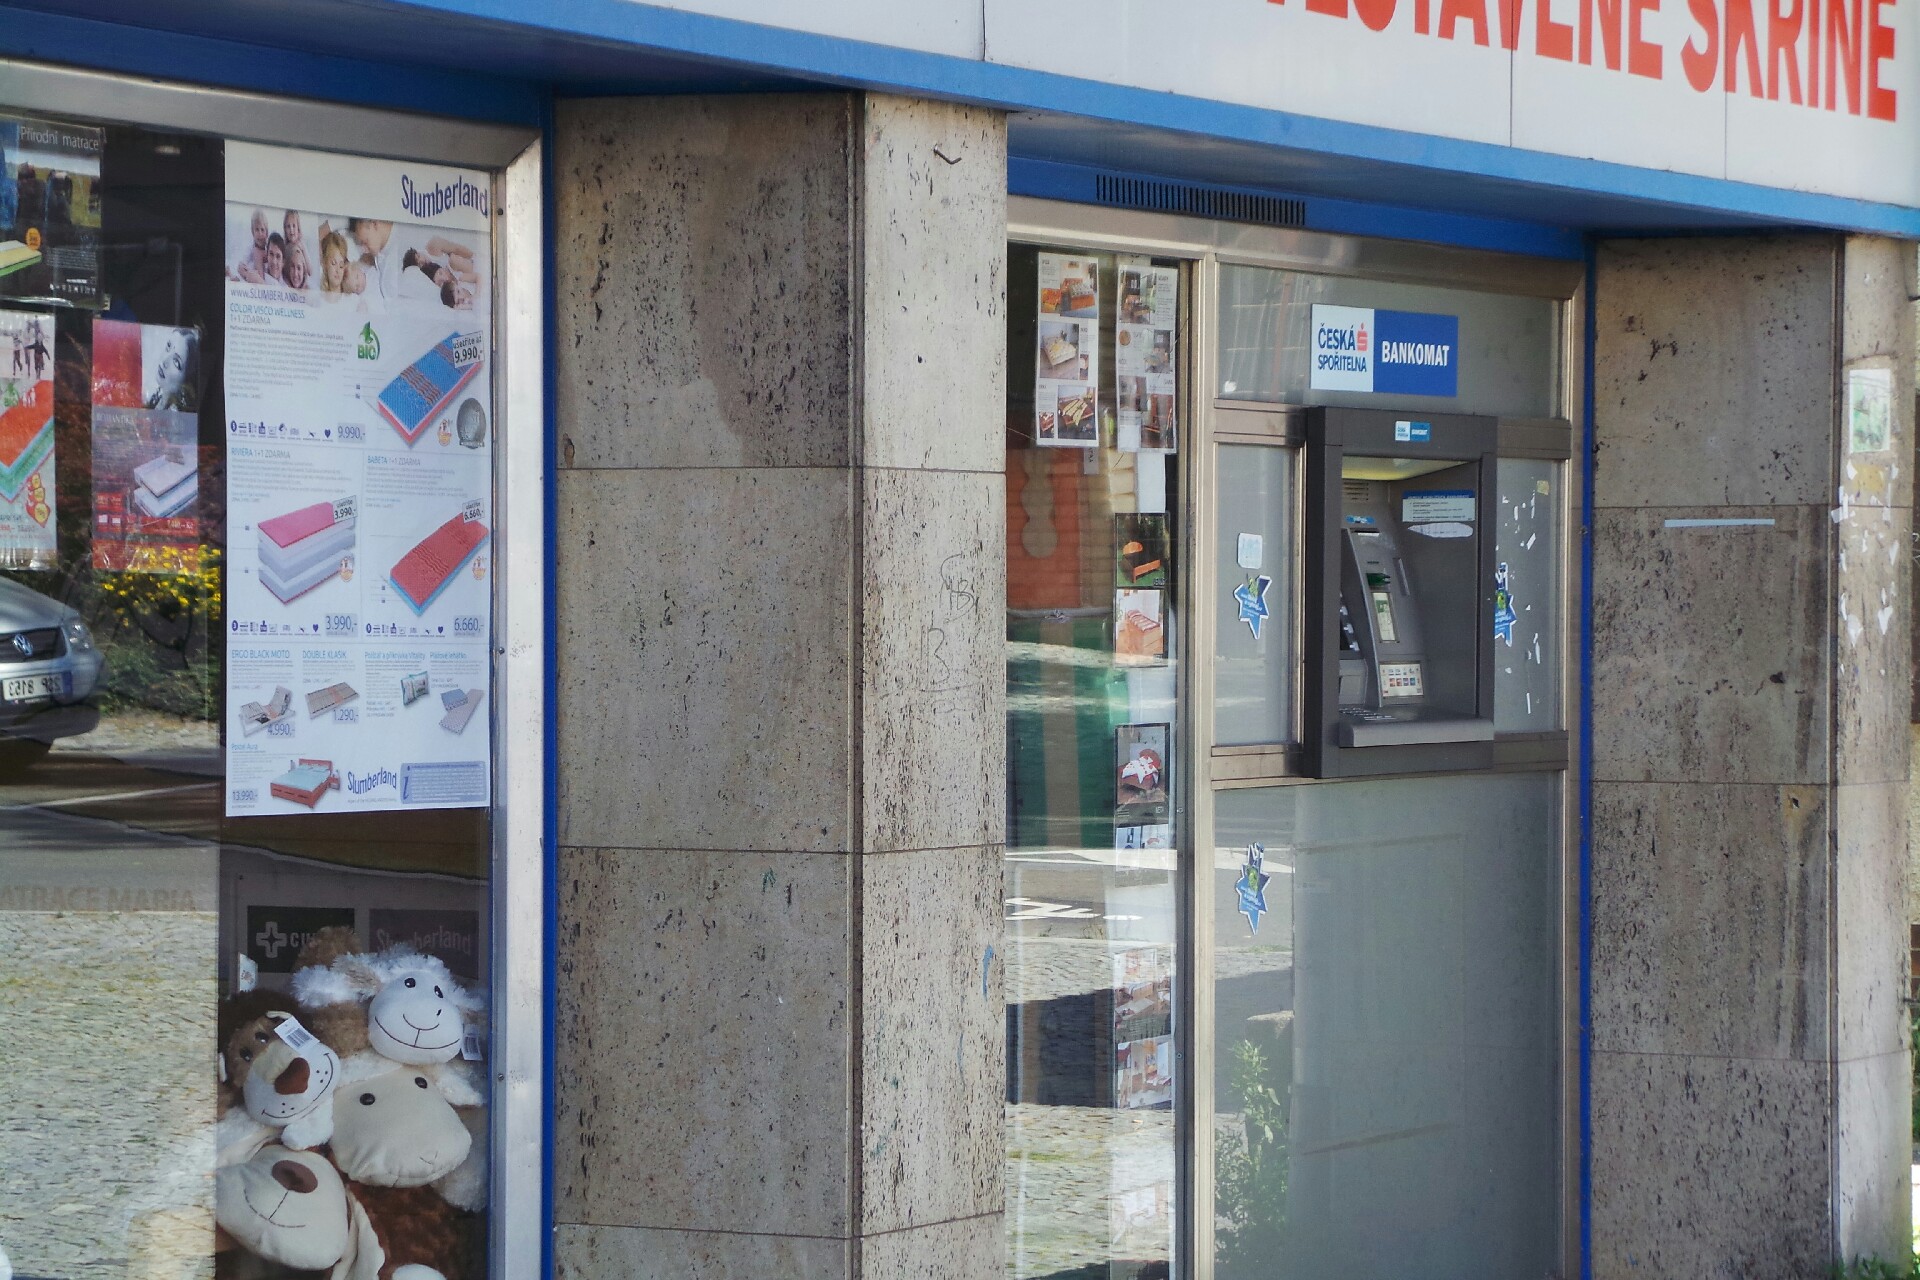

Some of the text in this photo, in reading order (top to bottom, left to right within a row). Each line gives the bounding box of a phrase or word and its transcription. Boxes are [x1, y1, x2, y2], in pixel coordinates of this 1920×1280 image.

[20, 126, 99, 151] Přírodní matrace
[401, 174, 488, 218] Slumberland
[242, 314, 271, 325] ZDARMA
[253, 305, 274, 316] VISCO
[274, 307, 305, 319] WELLNESS
[1318, 322, 1355, 350] ČESKÁ
[1382, 340, 1450, 367] BANKOMAT
[1318, 352, 1367, 373] SPOŘITELNA
[337, 425, 366, 440] 9.990,-
[231, 447, 253, 457] RIVIERA
[265, 449, 291, 459] ZDARMA
[325, 615, 357, 632] 3.990,-
[454, 617, 484, 632] 6.660,-
[232, 649, 290, 659] ERGO BLACK MOTO
[302, 650, 347, 659] DOUBLE KLASIK
[333, 709, 359, 722] 1.290,-
[267, 723, 295, 736] 4.990,-
[347, 767, 397, 794] Slumberland
